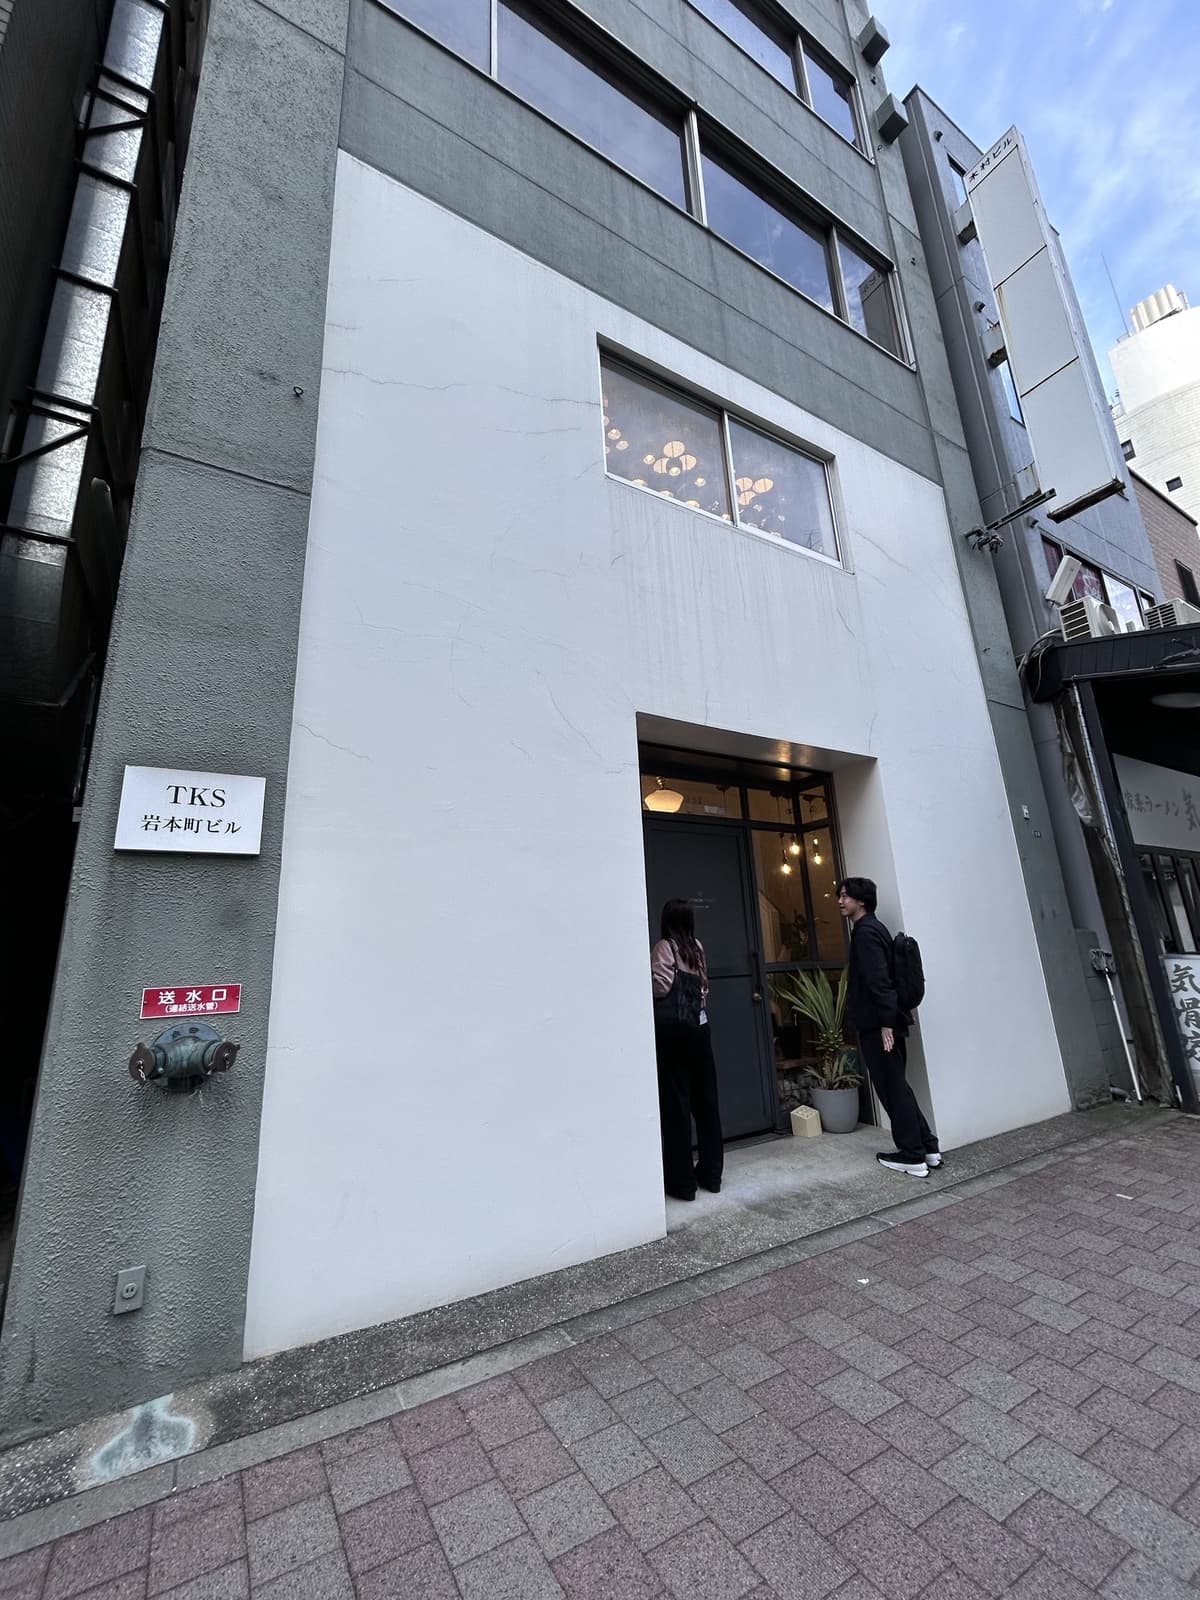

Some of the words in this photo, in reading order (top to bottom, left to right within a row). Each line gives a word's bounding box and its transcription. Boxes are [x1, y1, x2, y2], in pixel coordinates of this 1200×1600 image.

[968, 137, 1013, 183] 木村ビル
[166, 785, 226, 808] TKS
[141, 814, 242, 835] 岩本町ビル
[157, 988, 227, 1006] 送水口
